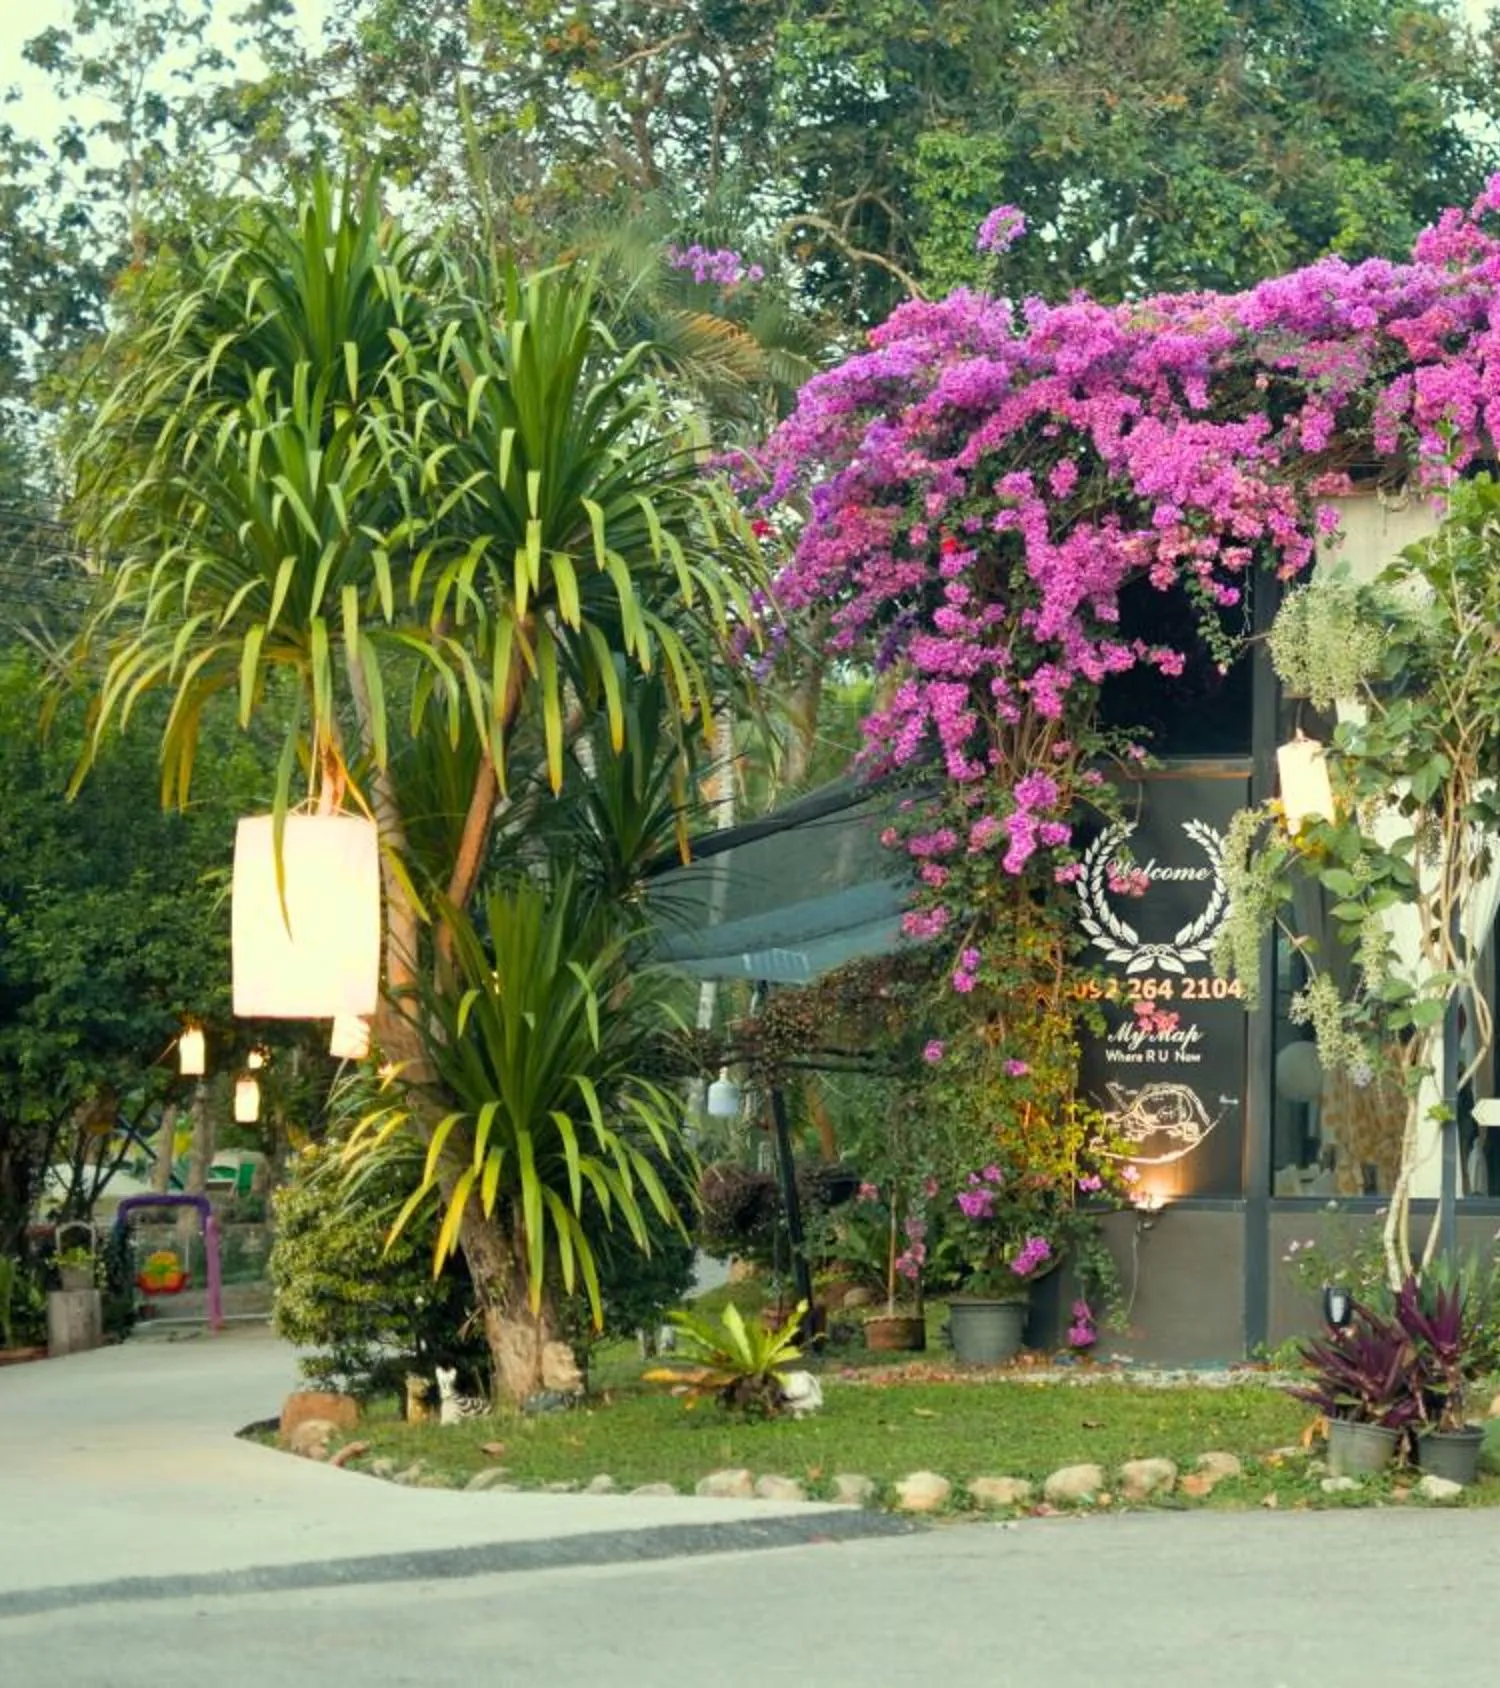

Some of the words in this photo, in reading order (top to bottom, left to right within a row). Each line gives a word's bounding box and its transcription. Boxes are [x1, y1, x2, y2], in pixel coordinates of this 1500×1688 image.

[1106, 858, 1212, 881] Wlcome
[1127, 977, 1174, 1000] 264
[1181, 977, 1243, 1000] 2104
[1107, 1021, 1146, 1051] My
[1105, 1049, 1143, 1063] Where
[1145, 1049, 1156, 1063] R
[1158, 1049, 1169, 1063] U
[1174, 1049, 1201, 1063] Now
